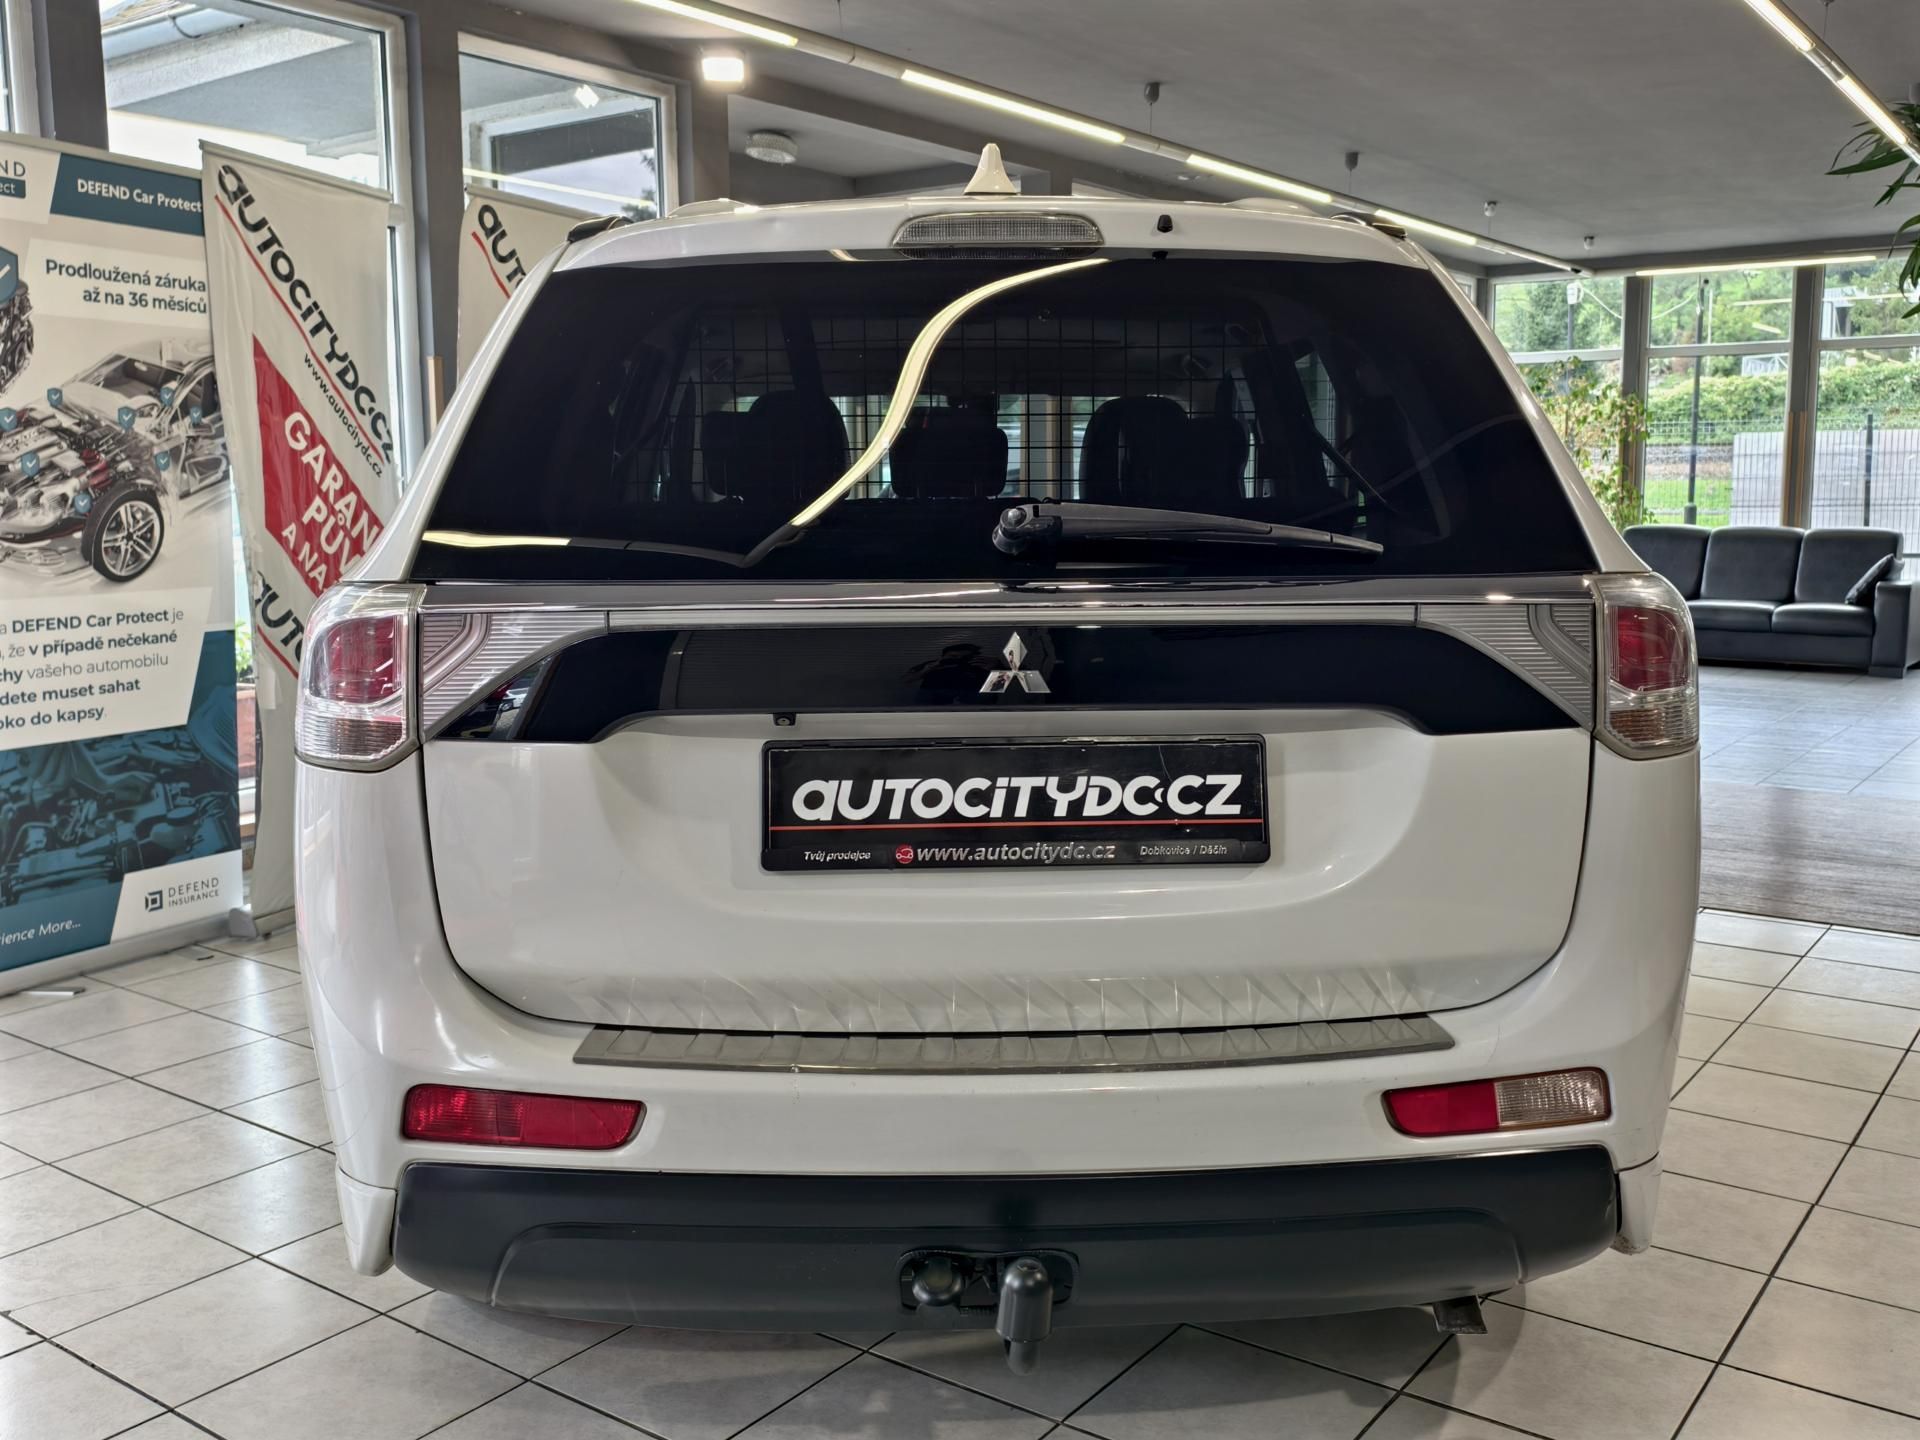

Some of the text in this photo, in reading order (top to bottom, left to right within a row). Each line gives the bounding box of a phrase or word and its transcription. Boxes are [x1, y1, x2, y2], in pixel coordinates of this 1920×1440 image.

[77, 178, 203, 213] DEFEND Car Protect
[477, 204, 527, 289] aUT
[45, 258, 207, 292] Prodloužená záruka
[83, 287, 208, 314] až na 36 měsíců
[304, 353, 383, 478] www.autocitydc.cz
[284, 411, 380, 554] GARAN
[281, 522, 297, 549] A
[12, 615, 82, 634] DEFEND
[86, 614, 112, 628] Car
[116, 610, 169, 625] Protect
[171, 607, 184, 624] je
[8, 643, 25, 658] že
[29, 645, 38, 655] v
[42, 637, 104, 659] případě
[108, 630, 178, 649] nečekané
[0, 653, 169, 685] hy vašeho automobilu
[42, 684, 95, 701] muset
[98, 678, 141, 695] sahat
[30, 711, 53, 726] do
[804, 850, 871, 862] Tvůj prodejce
[917, 842, 1116, 864] www.autocitydc.cz
[168, 877, 219, 899] DEFEND
[168, 889, 220, 908] INSURANCE
[0, 919, 81, 946] ience More...
